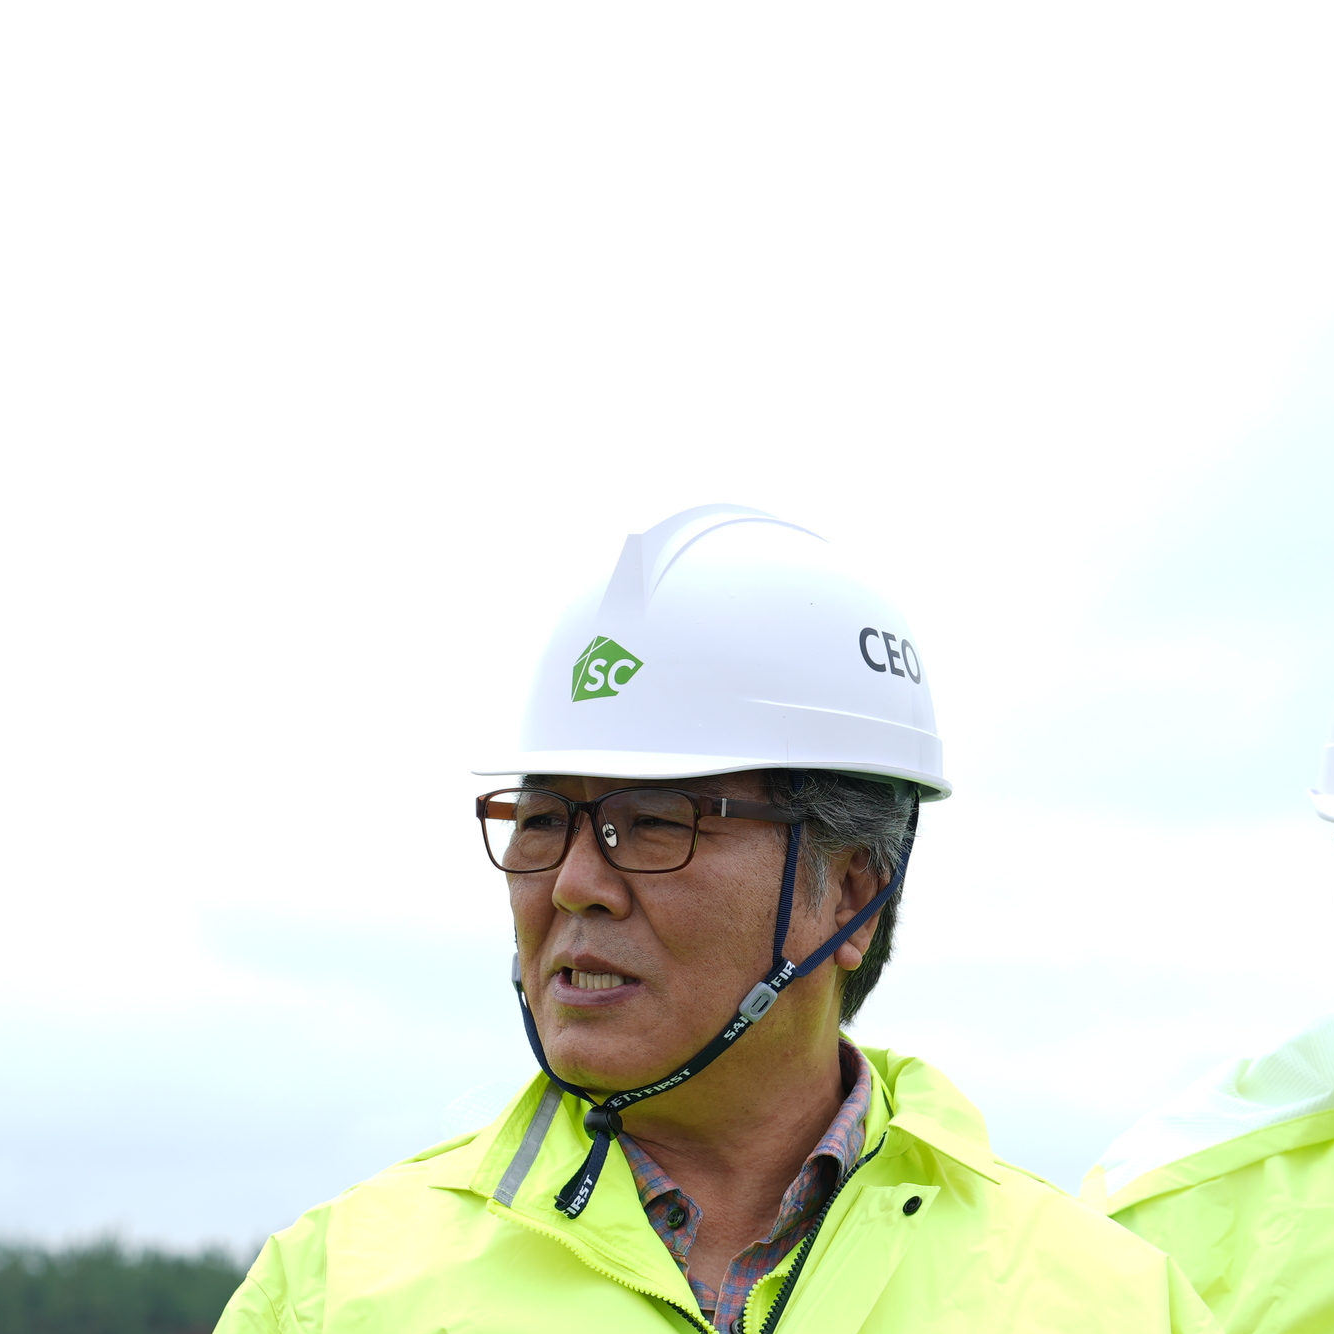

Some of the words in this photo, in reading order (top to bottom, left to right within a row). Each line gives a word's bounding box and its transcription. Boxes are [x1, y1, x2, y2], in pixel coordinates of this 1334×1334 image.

[584, 658, 637, 692] SC
[859, 627, 921, 685] CEO
[607, 1068, 691, 1108] ETYFIRST
